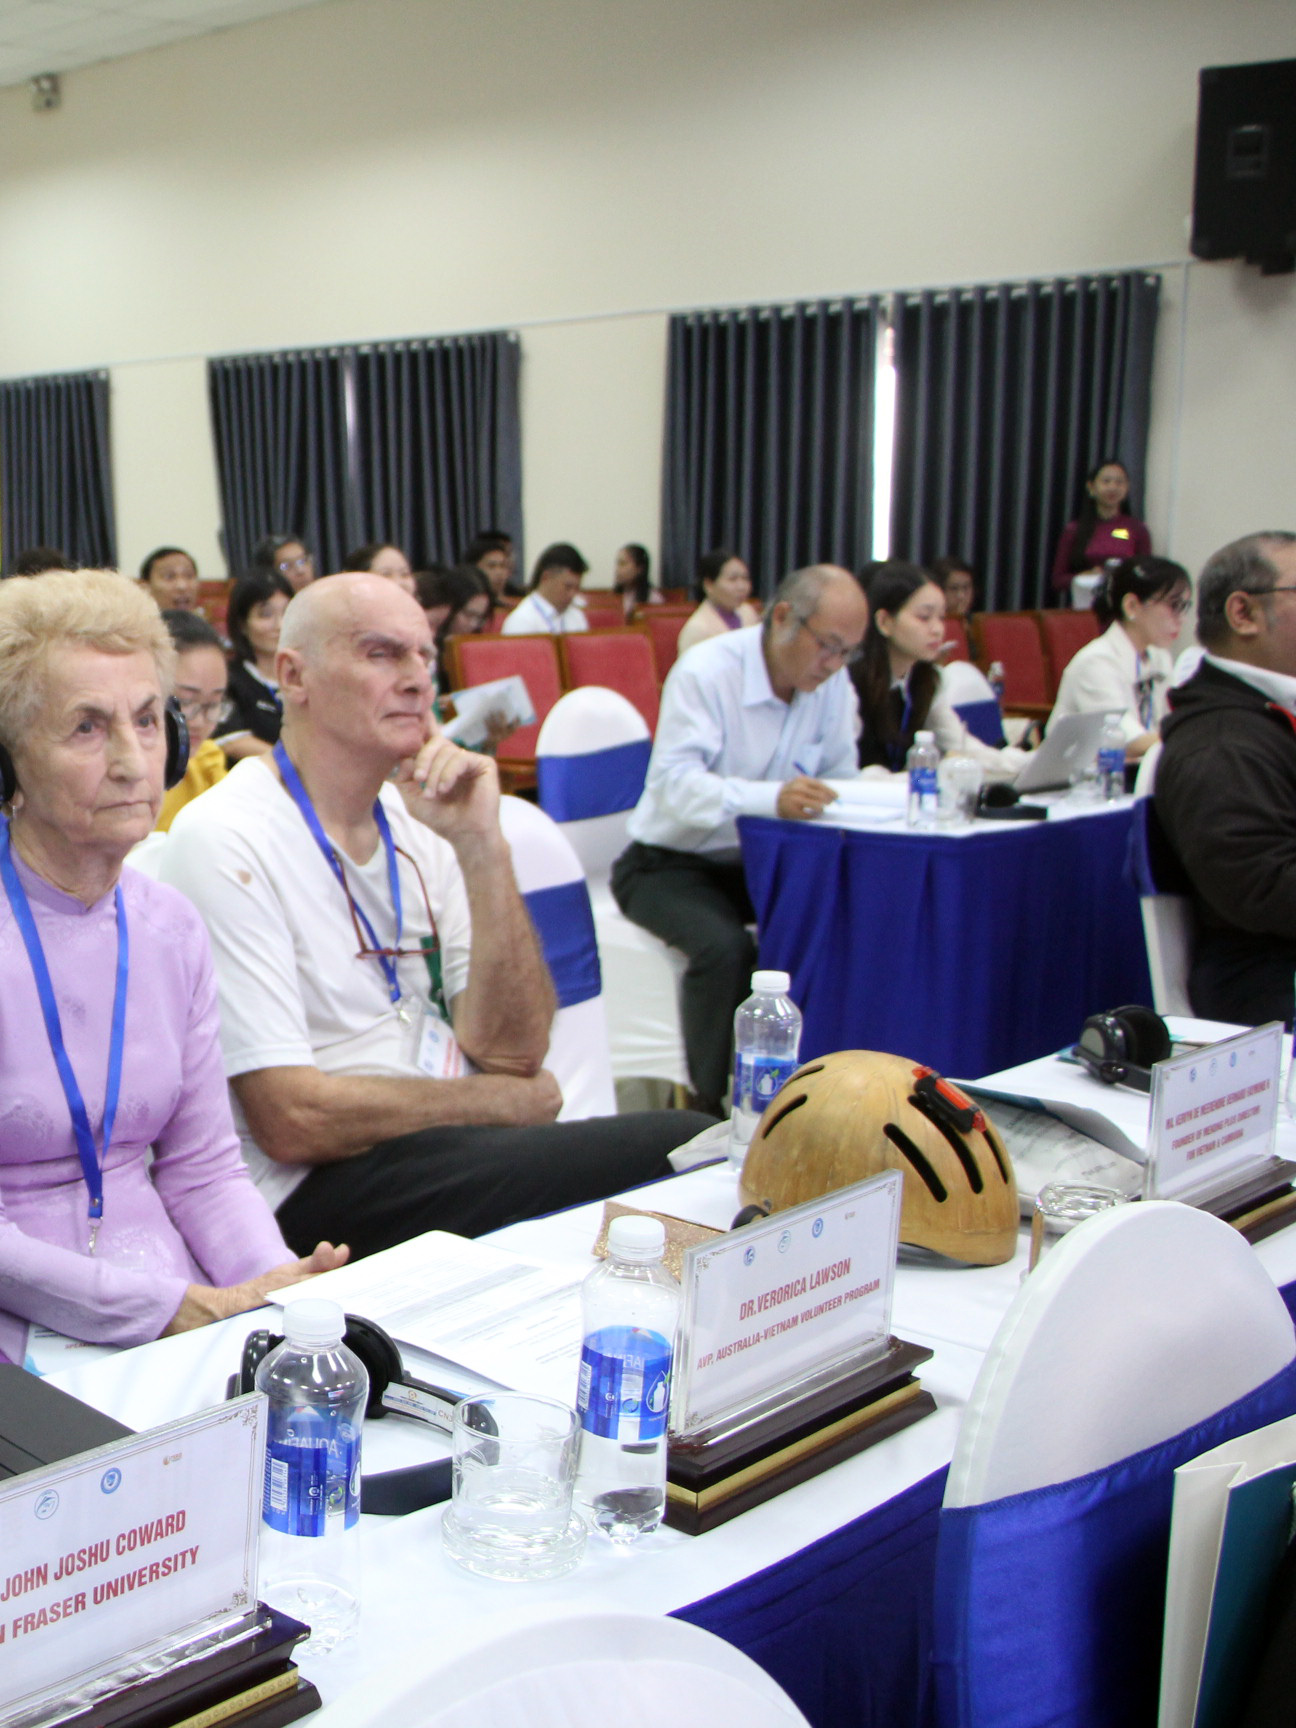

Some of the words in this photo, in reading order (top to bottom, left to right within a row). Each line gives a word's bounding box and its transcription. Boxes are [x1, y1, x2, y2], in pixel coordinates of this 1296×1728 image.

[809, 1257, 851, 1291] LAWSON
[716, 1314, 798, 1362] AUSTRALIA-VIETNAM
[800, 1295, 843, 1324] VOLUNTEER
[844, 1278, 880, 1305] PROGRAM
[0, 1563, 48, 1602] JOHN
[54, 1539, 111, 1581] JOSHU
[115, 1509, 186, 1556] COWARD
[12, 1591, 87, 1639] FRASER
[93, 1545, 200, 1605] UNIVERSITY
